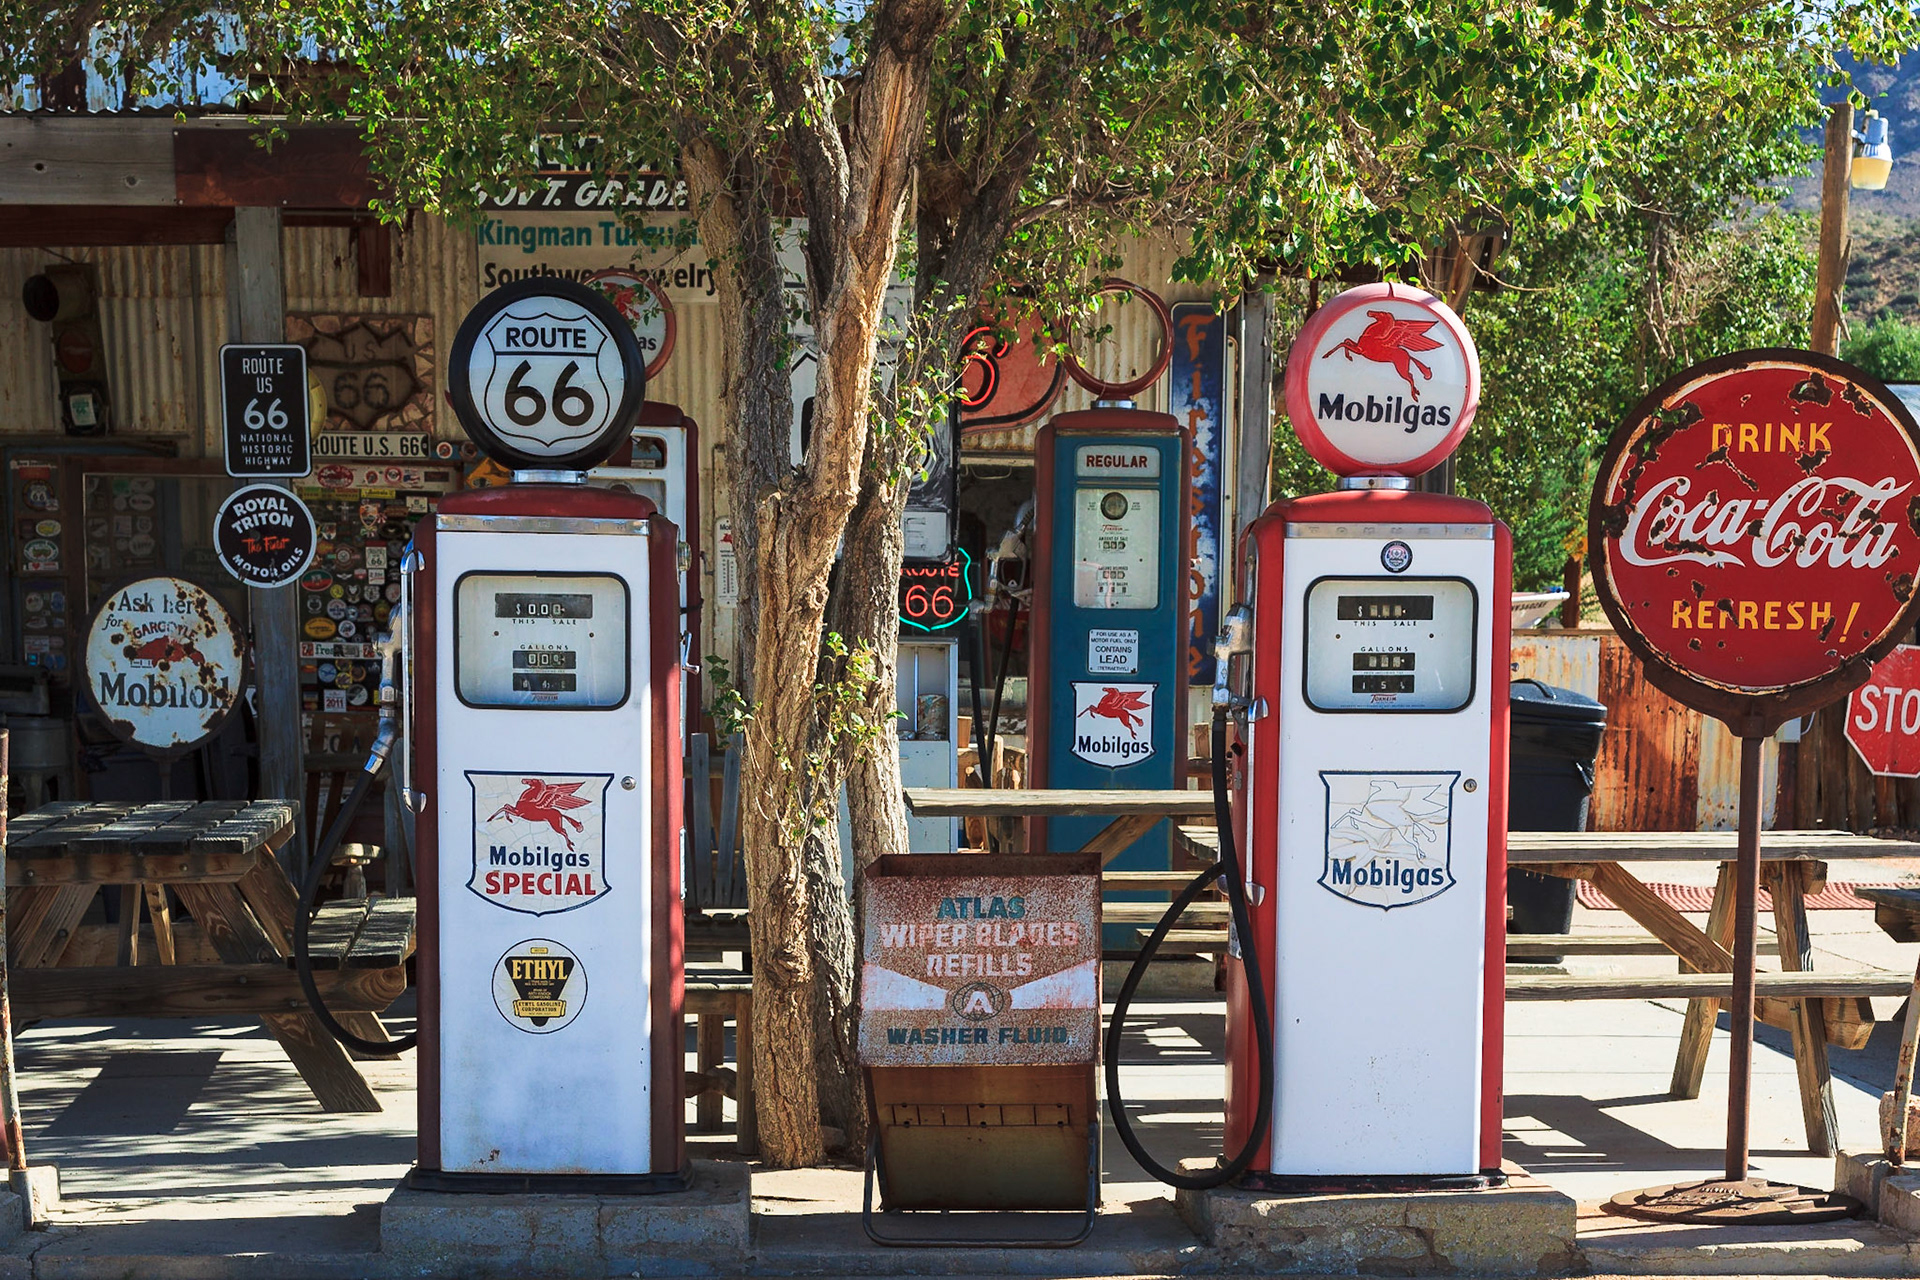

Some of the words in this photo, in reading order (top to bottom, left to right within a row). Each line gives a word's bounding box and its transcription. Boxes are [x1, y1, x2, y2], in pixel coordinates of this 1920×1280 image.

[478, 219, 592, 253] Kingman
[506, 326, 587, 349] ROUTE
[242, 358, 284, 374] ROUTE
[256, 377, 273, 393] US
[334, 372, 390, 410] 66
[504, 359, 594, 427] 66
[244, 398, 288, 430] 66
[1318, 392, 1451, 434] Mobilgas
[240, 433, 294, 443] NATIONAL
[364, 437, 393, 456] U.S.
[400, 437, 419, 456] 66
[1712, 422, 1834, 453] DRINK
[241, 445, 293, 454] HISTORIC
[244, 456, 292, 466] HIGHWAY
[1086, 455, 1148, 468] REGULAR
[232, 497, 288, 517] ROYAL
[231, 512, 294, 534] TRITON
[1618, 475, 1912, 569] Coca-Cola
[241, 537, 262, 554] The
[232, 554, 278, 577] MOTOR
[281, 547, 304, 572] OILS
[118, 590, 154, 613] Ask
[905, 584, 954, 618] 66
[102, 614, 124, 631] for
[1095, 645, 1132, 653] CONTAINS
[1099, 655, 1127, 664] LEAD
[1855, 685, 1920, 732] STO
[1078, 735, 1150, 758] Mobilgas
[489, 846, 590, 872] Mobilgas
[485, 872, 596, 896] SPECIAL
[1332, 858, 1445, 893] Mobilgas
[937, 896, 1025, 919] ATLAS
[512, 959, 568, 980] ETHYL
[887, 1027, 988, 1045] WASHER
[998, 1026, 1068, 1045] FLUID
